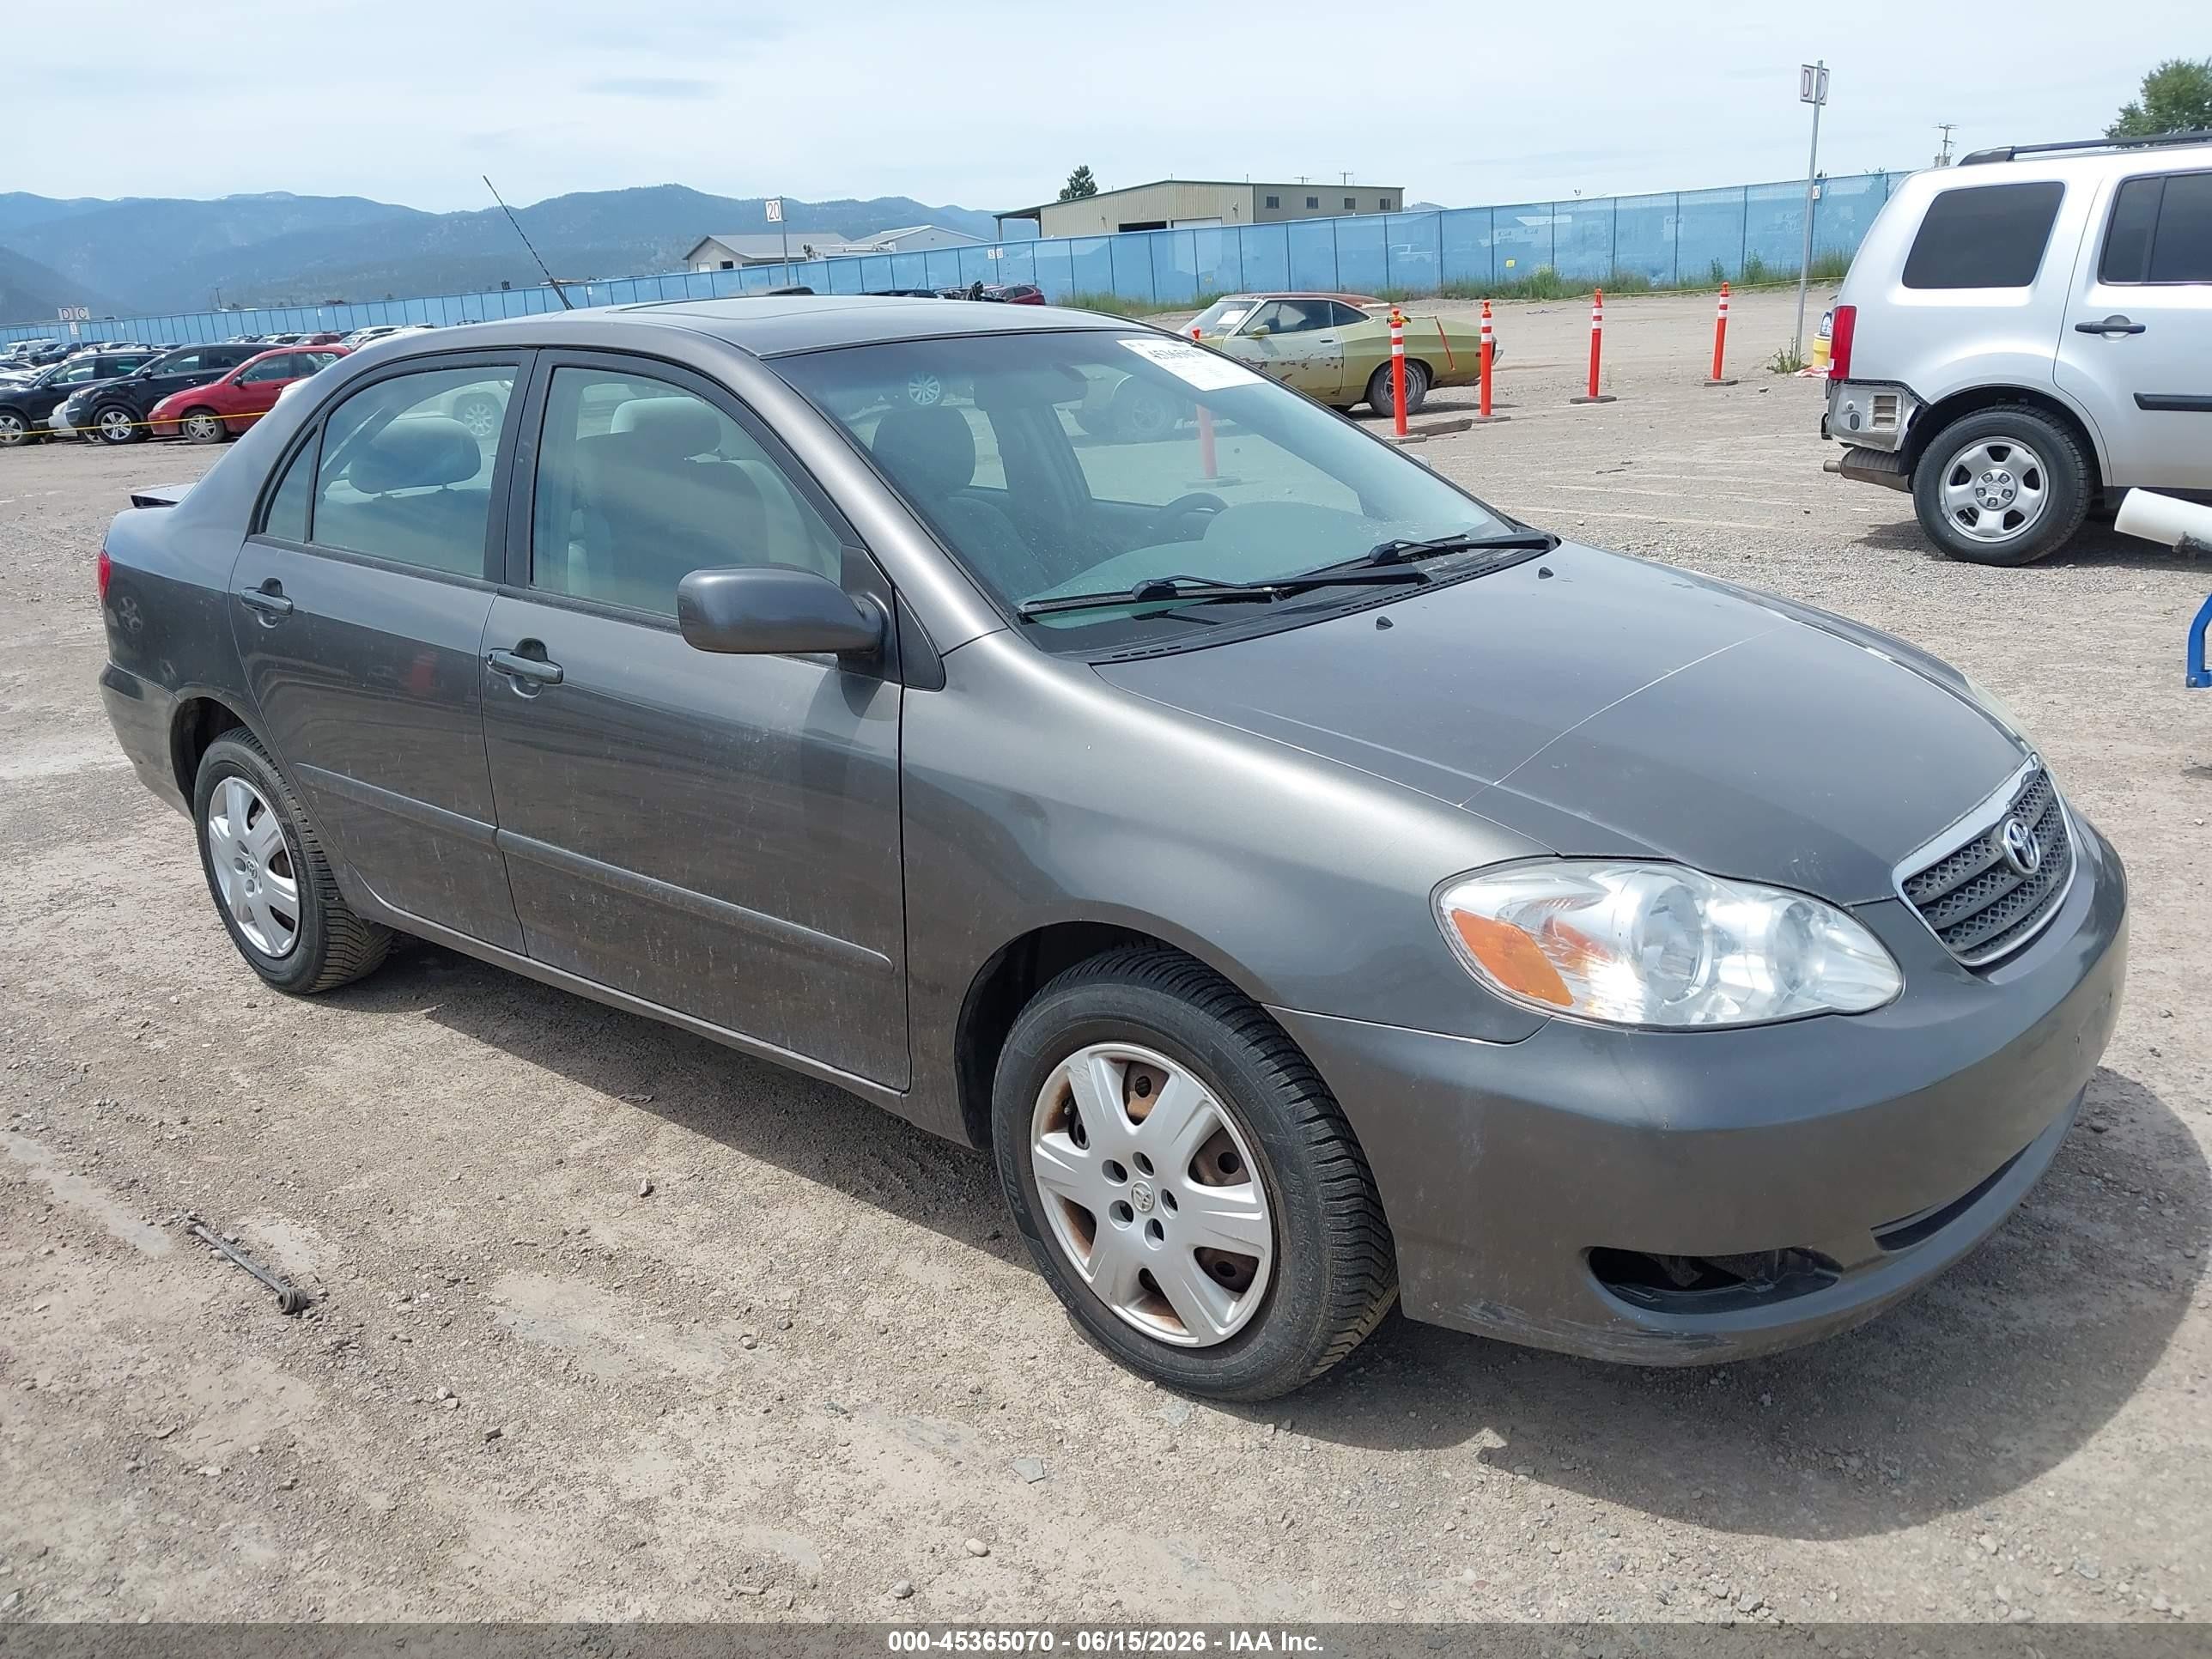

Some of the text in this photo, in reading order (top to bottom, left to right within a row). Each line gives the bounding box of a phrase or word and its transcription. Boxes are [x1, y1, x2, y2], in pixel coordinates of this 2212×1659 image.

[1803, 69, 1811, 97] D
[768, 202, 781, 220] 20
[61, 307, 87, 319] D C
